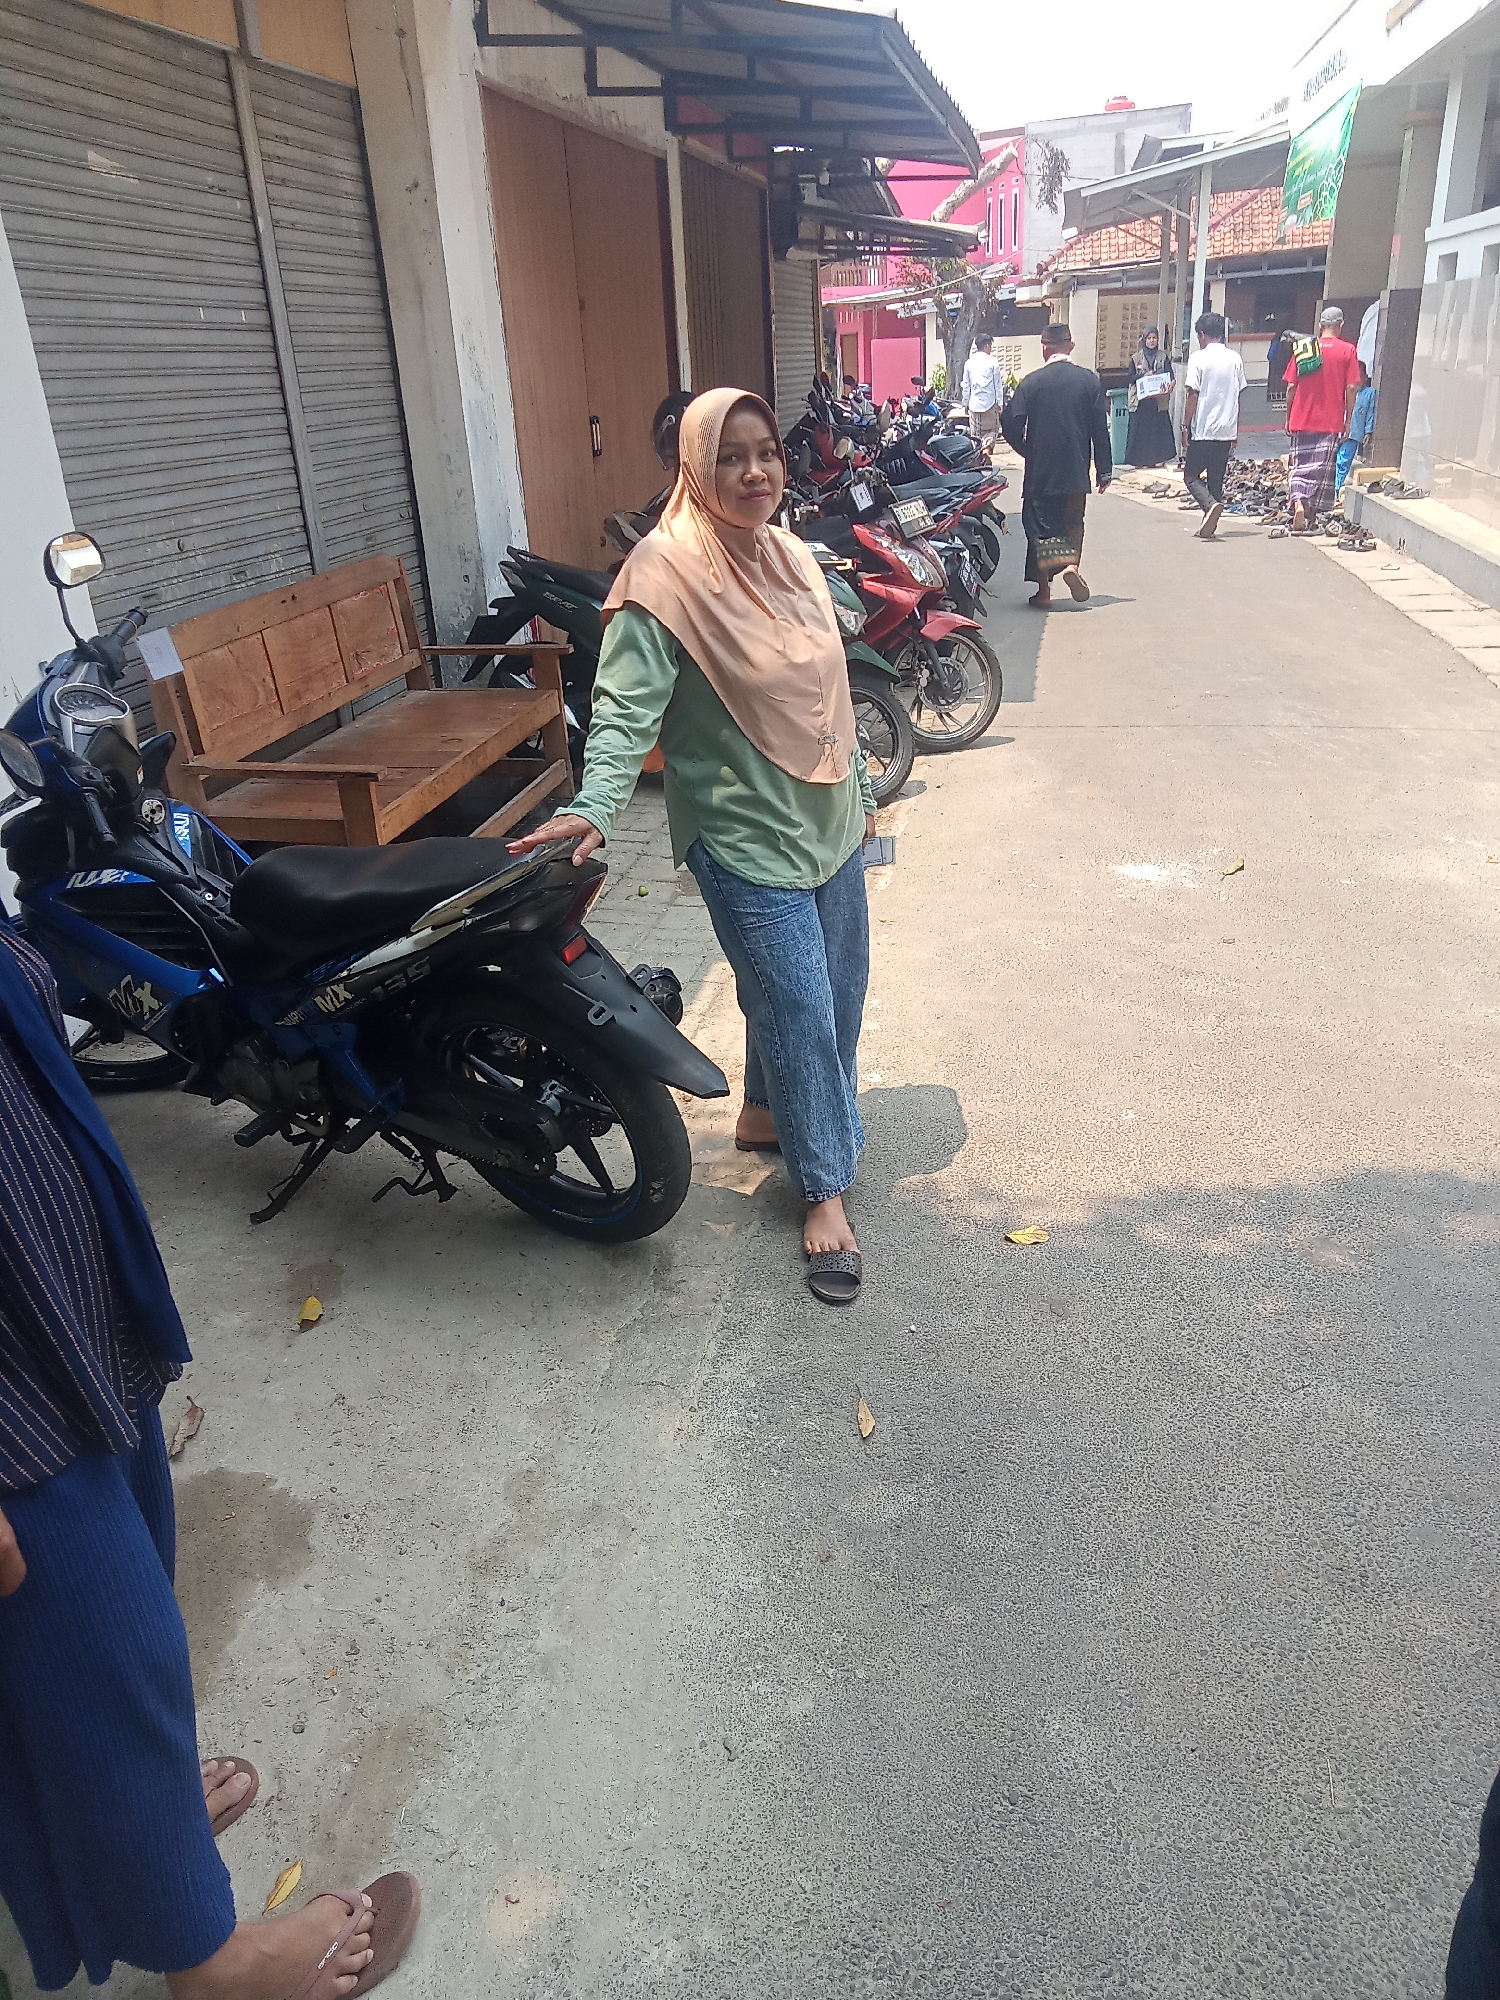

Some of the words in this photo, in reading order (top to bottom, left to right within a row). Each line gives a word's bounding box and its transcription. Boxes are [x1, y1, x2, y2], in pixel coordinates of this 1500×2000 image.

[107, 975, 161, 1020] MX
[312, 982, 355, 1013] MX
[370, 956, 431, 1001] 135
